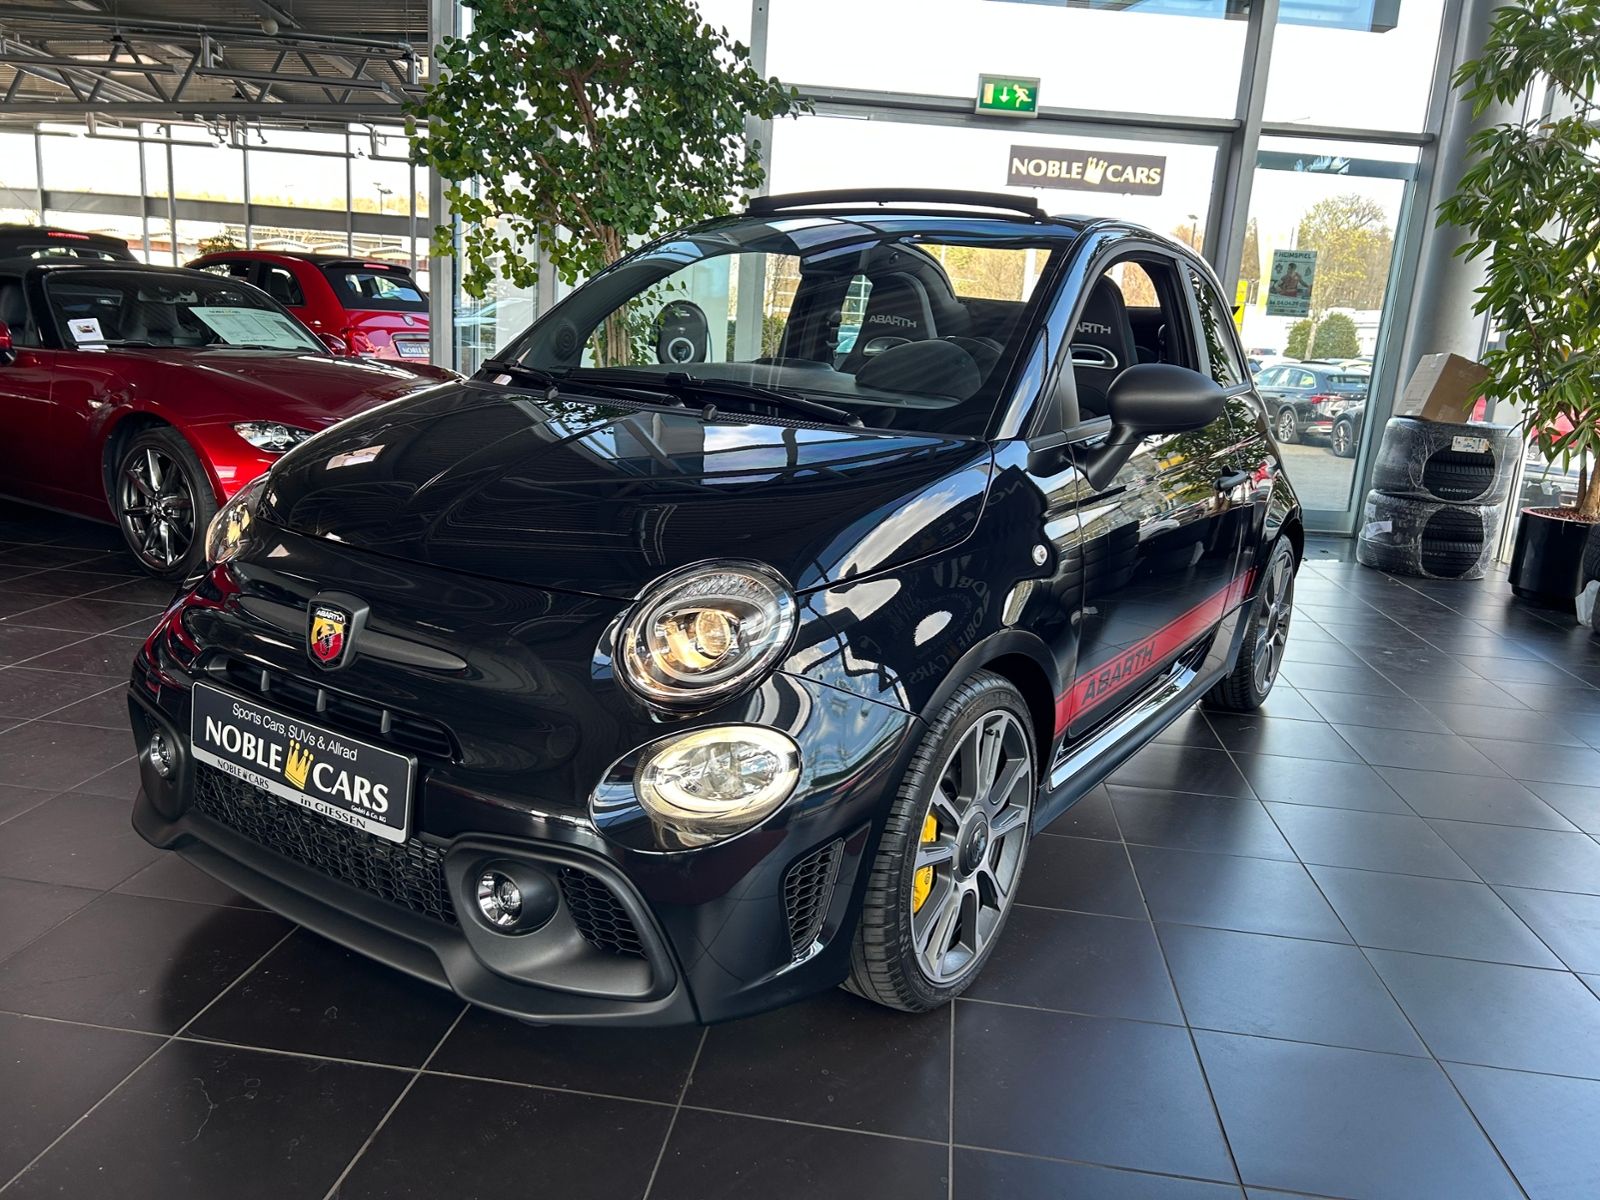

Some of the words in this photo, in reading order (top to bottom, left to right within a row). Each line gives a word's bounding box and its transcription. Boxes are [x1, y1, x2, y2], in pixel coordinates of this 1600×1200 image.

[1011, 157, 1083, 180] NOBLE
[1106, 164, 1161, 185] CARS
[869, 314, 917, 328] ABARTH
[316, 610, 344, 622] ABARTH
[1081, 641, 1156, 705] ABARTH
[232, 703, 262, 726] Sports
[262, 715, 287, 738] Cars,
[288, 724, 316, 747] SUVs
[317, 735, 326, 751] &
[326, 740, 358, 762] Allrad
[205, 715, 283, 773] NOBLE
[312, 762, 389, 813] CARS
[217, 759, 242, 778] NOBLE
[248, 773, 270, 790] CARS
[300, 795, 311, 808] in
[315, 802, 366, 829] GIESSEN
